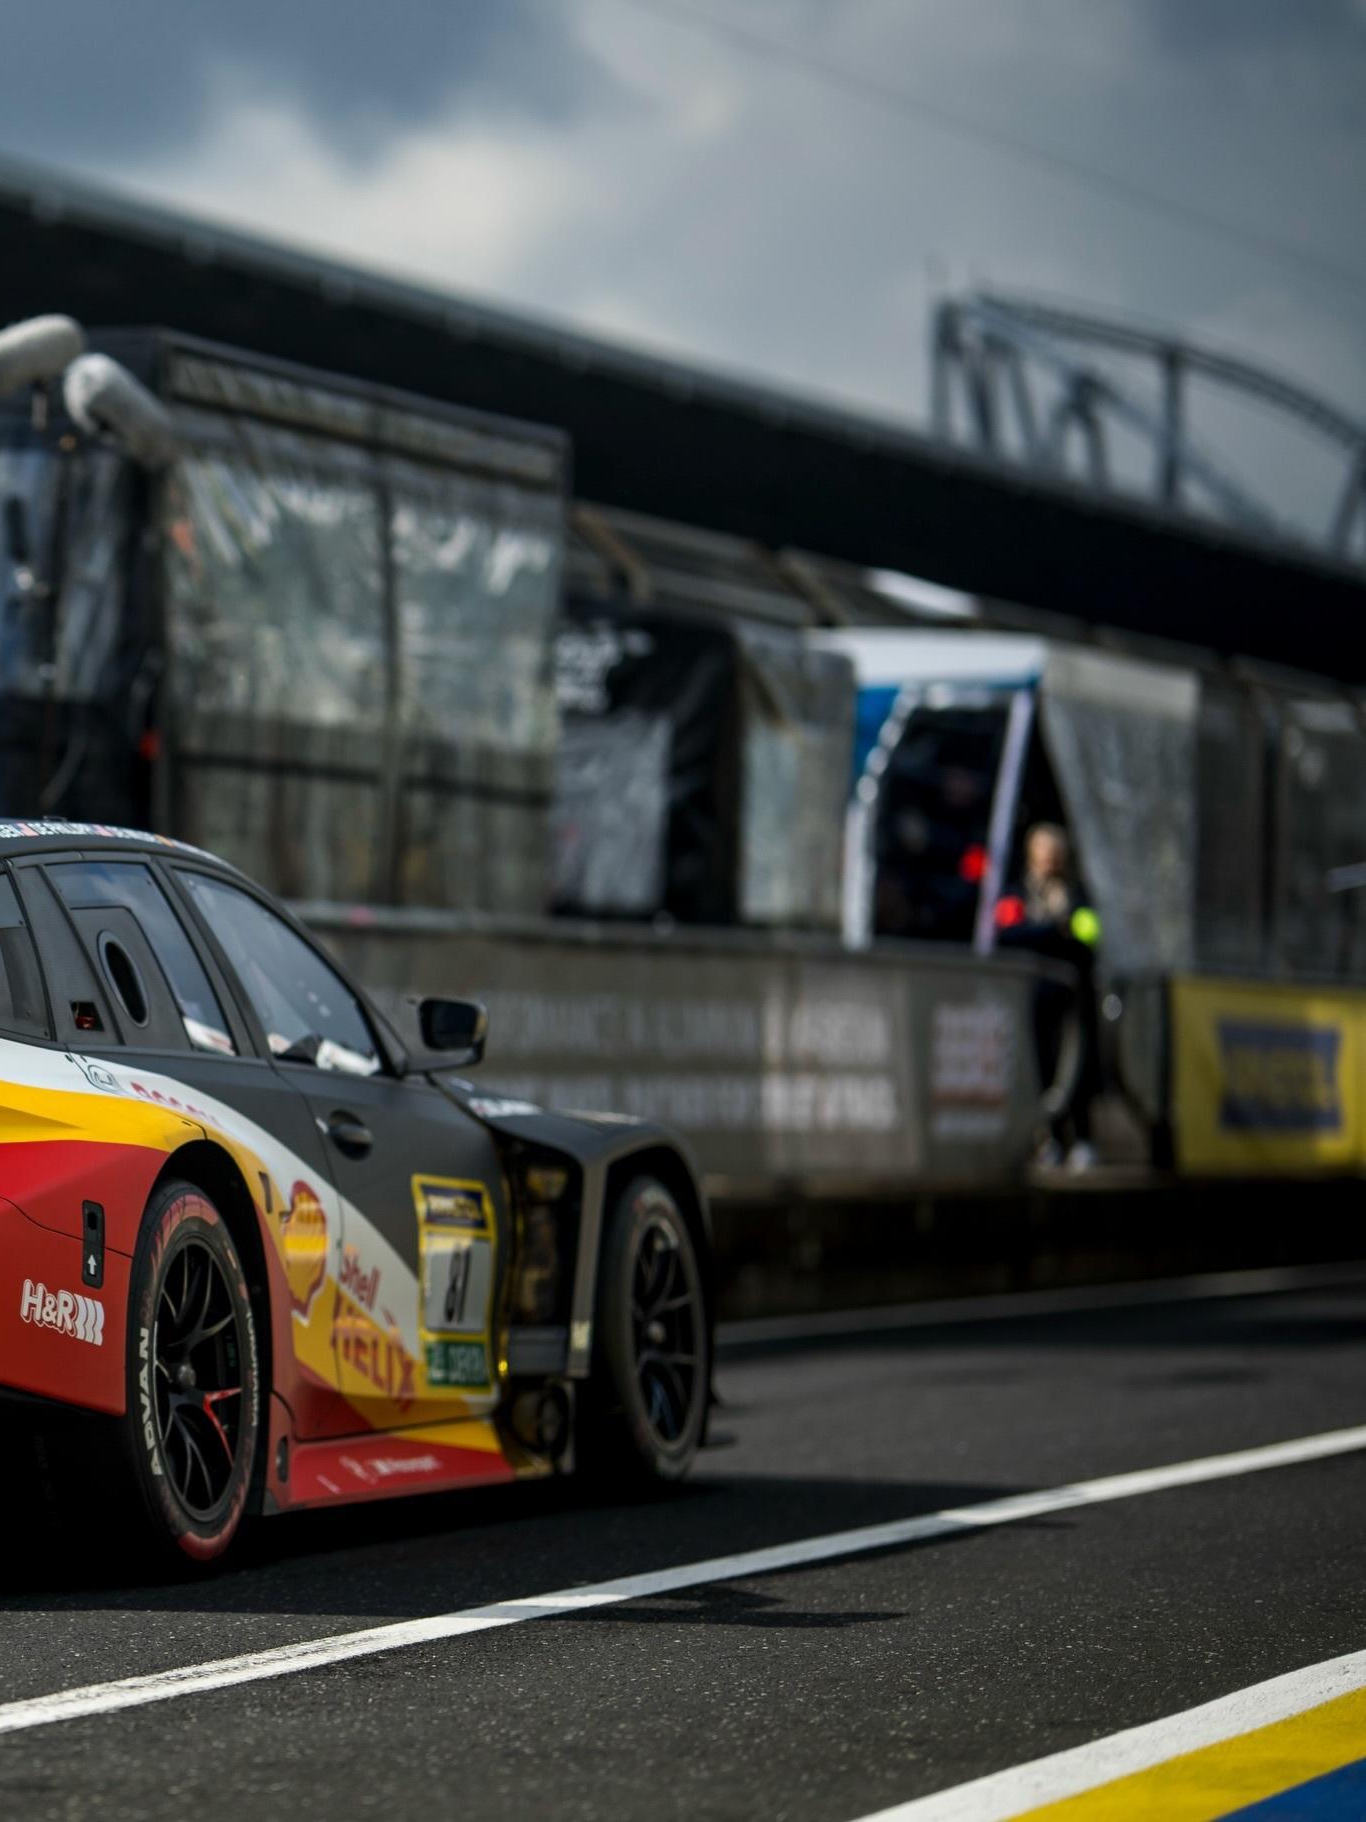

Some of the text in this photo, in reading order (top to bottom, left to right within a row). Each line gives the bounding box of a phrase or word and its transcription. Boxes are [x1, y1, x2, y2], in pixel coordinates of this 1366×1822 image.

[20, 1279, 76, 1338] H&R
[444, 1239, 472, 1323] 81
[139, 1327, 163, 1475] ADVAN
